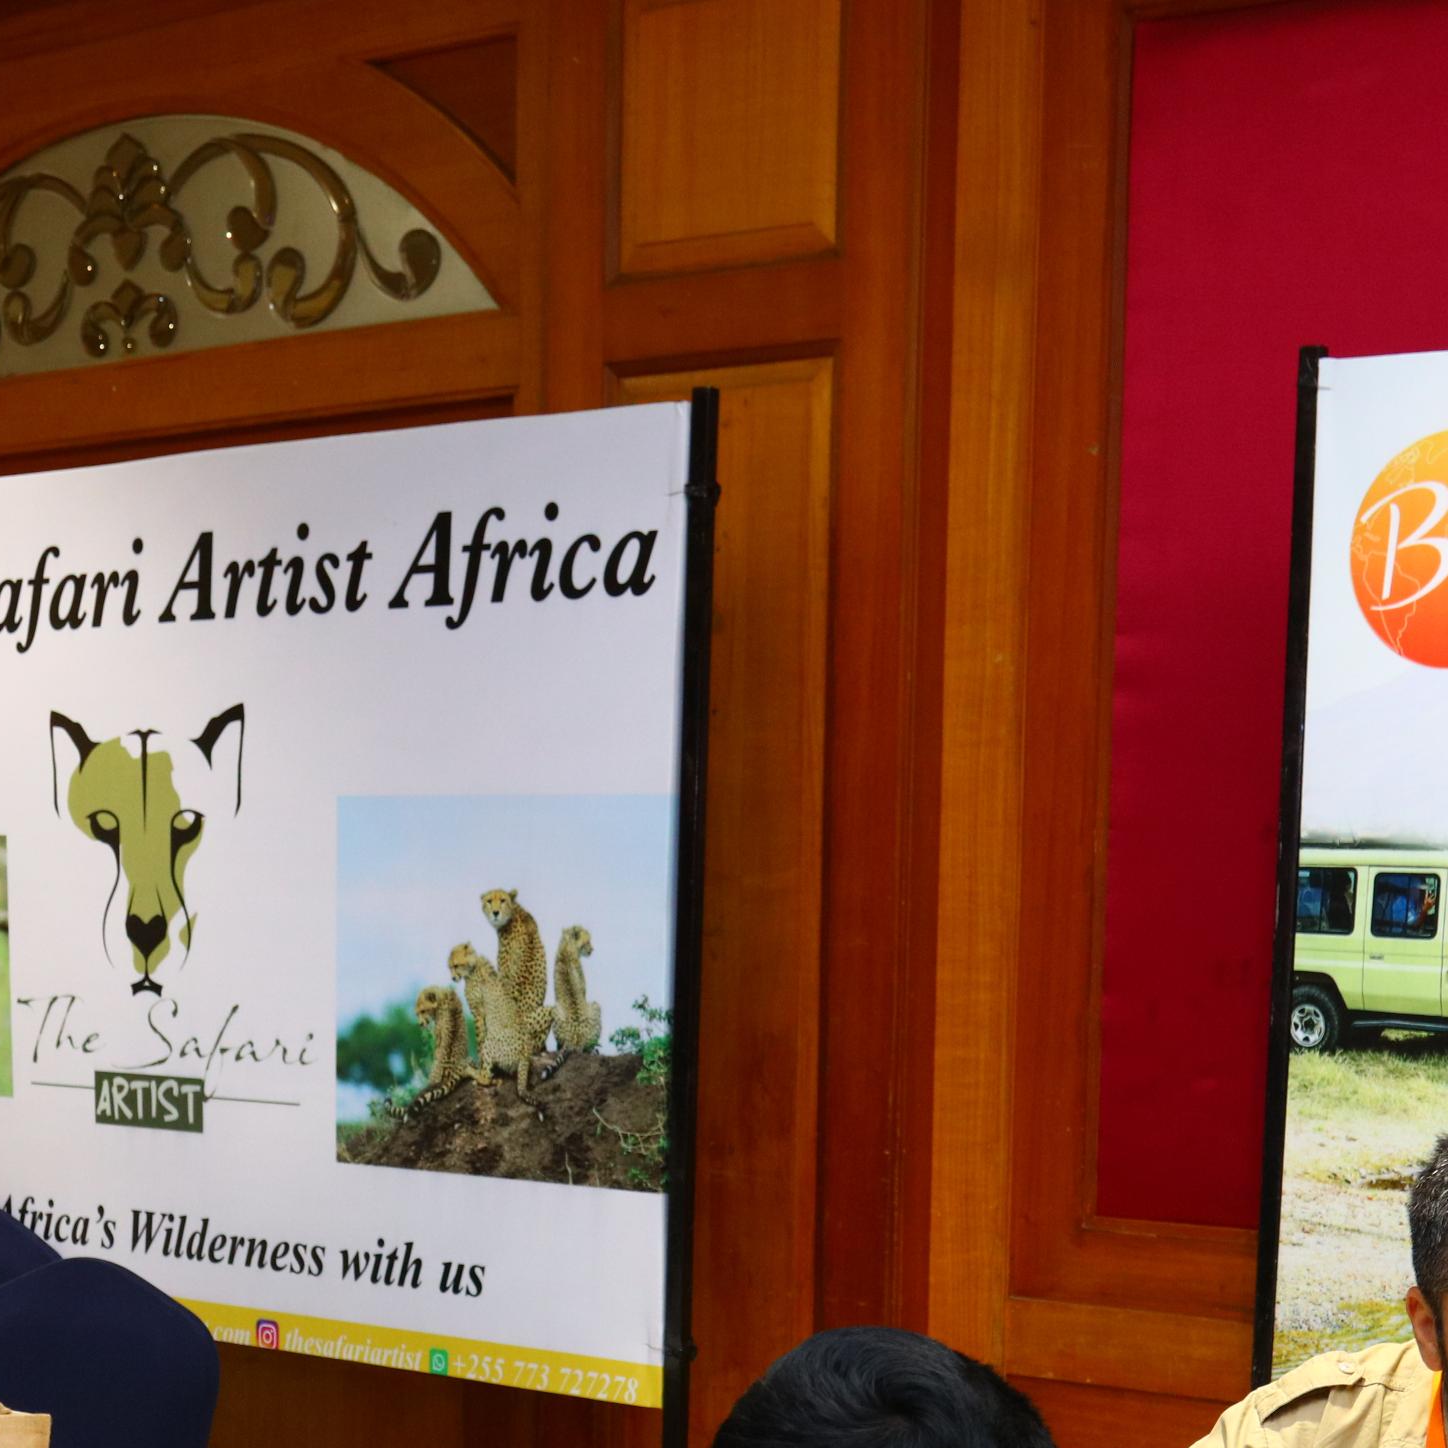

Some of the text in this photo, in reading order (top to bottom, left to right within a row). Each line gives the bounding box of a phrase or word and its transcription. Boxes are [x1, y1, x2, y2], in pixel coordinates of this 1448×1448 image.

[158, 522, 373, 625] Artist
[389, 501, 659, 631] Africa
[17, 994, 318, 1103] The Safari
[96, 1075, 202, 1124] ARTIST
[131, 1209, 326, 1277] Wilderness
[339, 1238, 422, 1289] with
[439, 1261, 485, 1297] us
[453, 1353, 504, 1385] +255
[513, 1361, 549, 1390] 773
[559, 1367, 639, 1404] 727278
